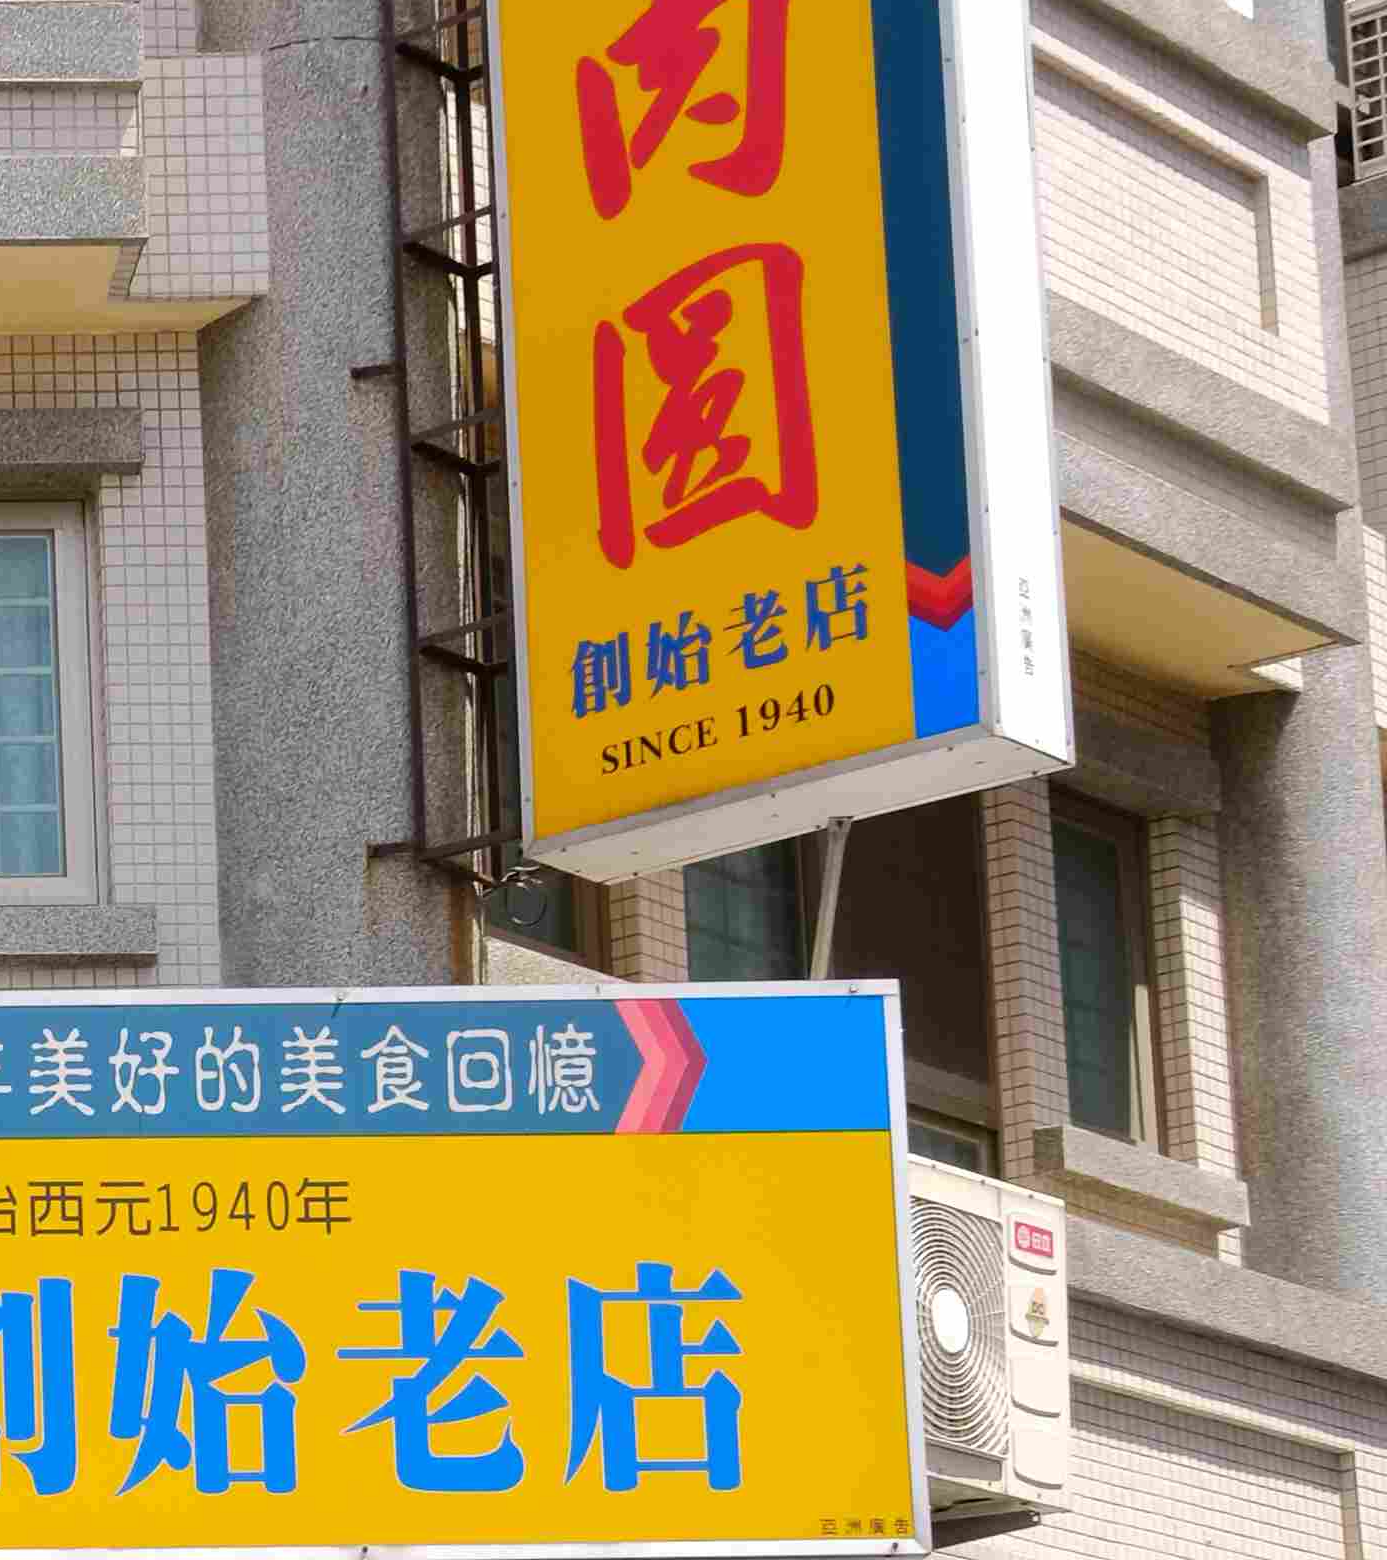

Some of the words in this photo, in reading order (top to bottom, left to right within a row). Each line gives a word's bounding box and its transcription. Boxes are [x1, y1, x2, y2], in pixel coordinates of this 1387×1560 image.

[570, 562, 872, 721] 創始老店
[600, 715, 718, 776] SINCE
[735, 684, 837, 740] 1940
